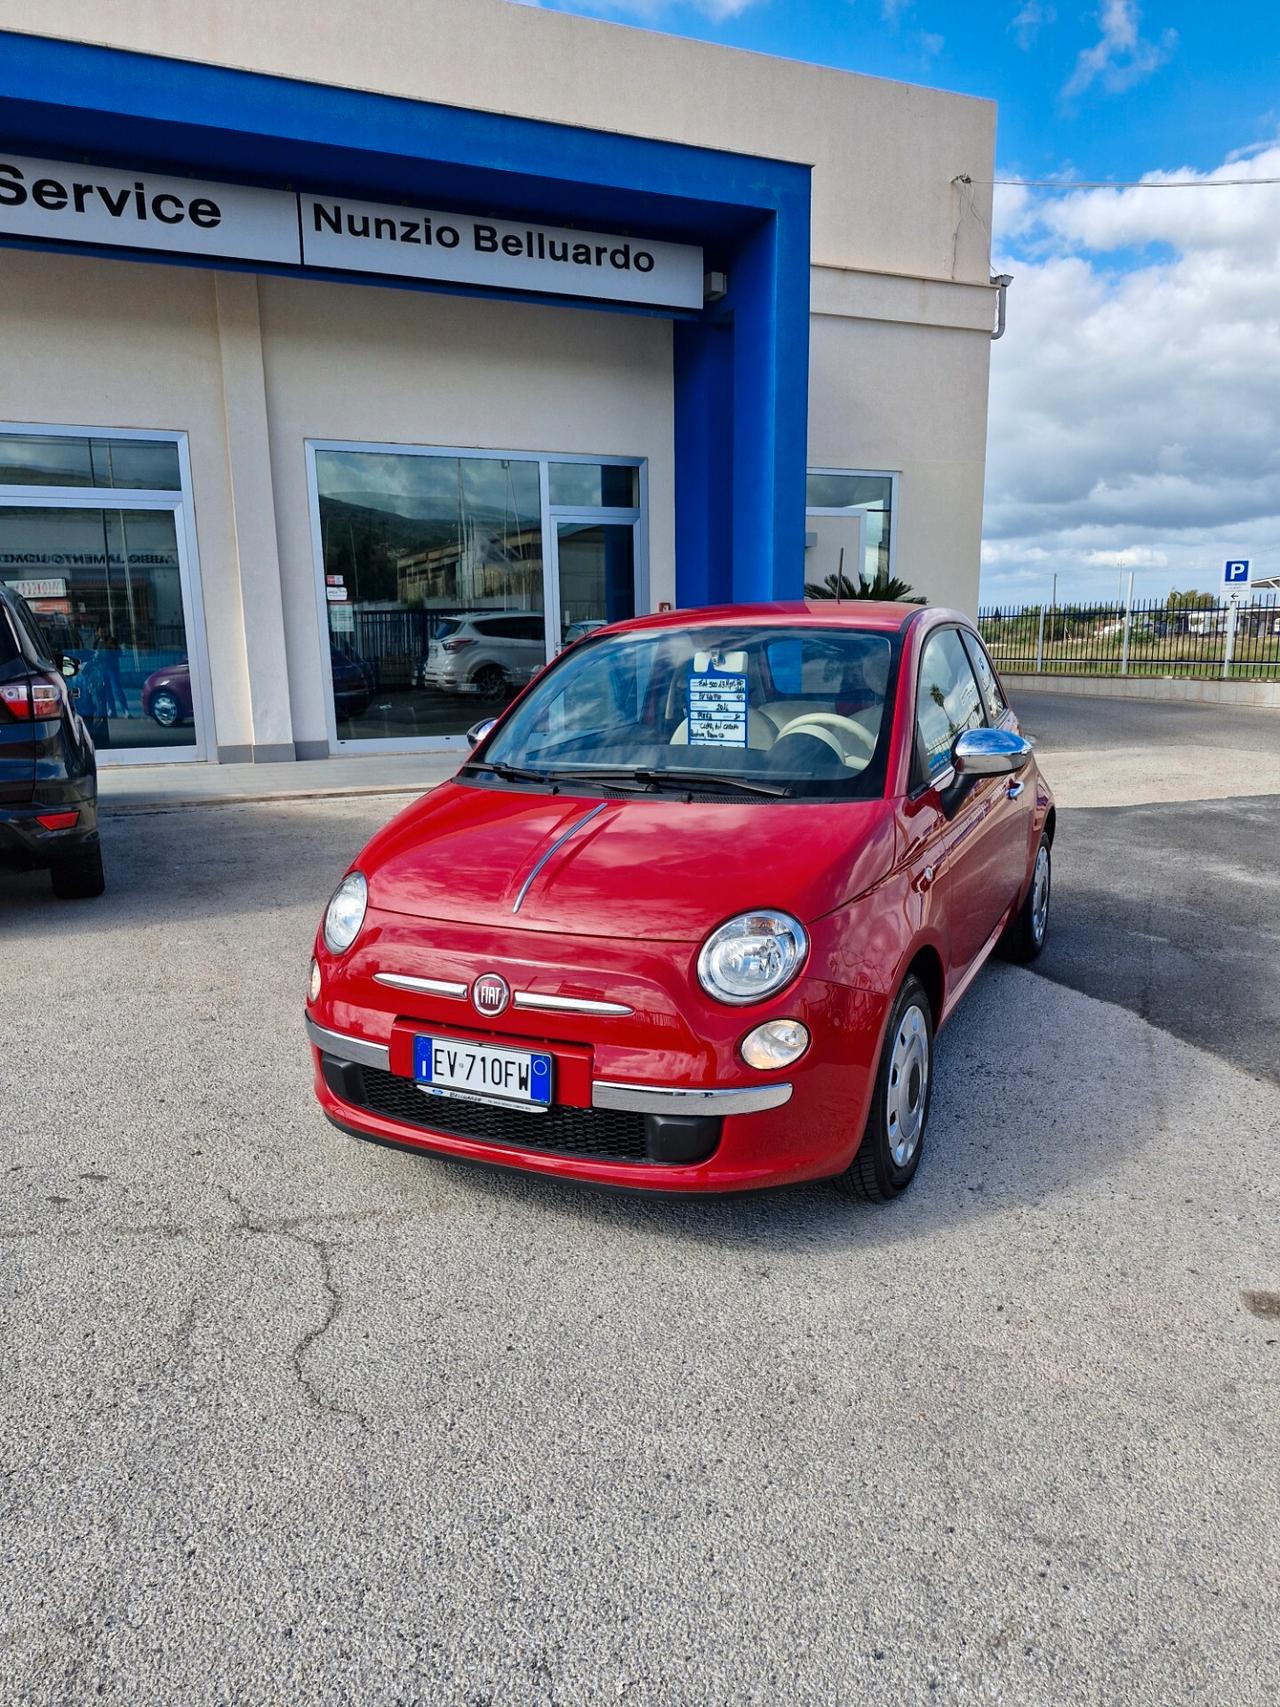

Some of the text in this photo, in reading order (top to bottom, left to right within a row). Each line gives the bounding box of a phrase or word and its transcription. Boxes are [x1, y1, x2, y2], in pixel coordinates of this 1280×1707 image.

[0, 164, 222, 228] Service
[313, 203, 655, 273] Nunzio Belluardo
[1230, 563, 1245, 580] P
[480, 985, 502, 1005] FIAT
